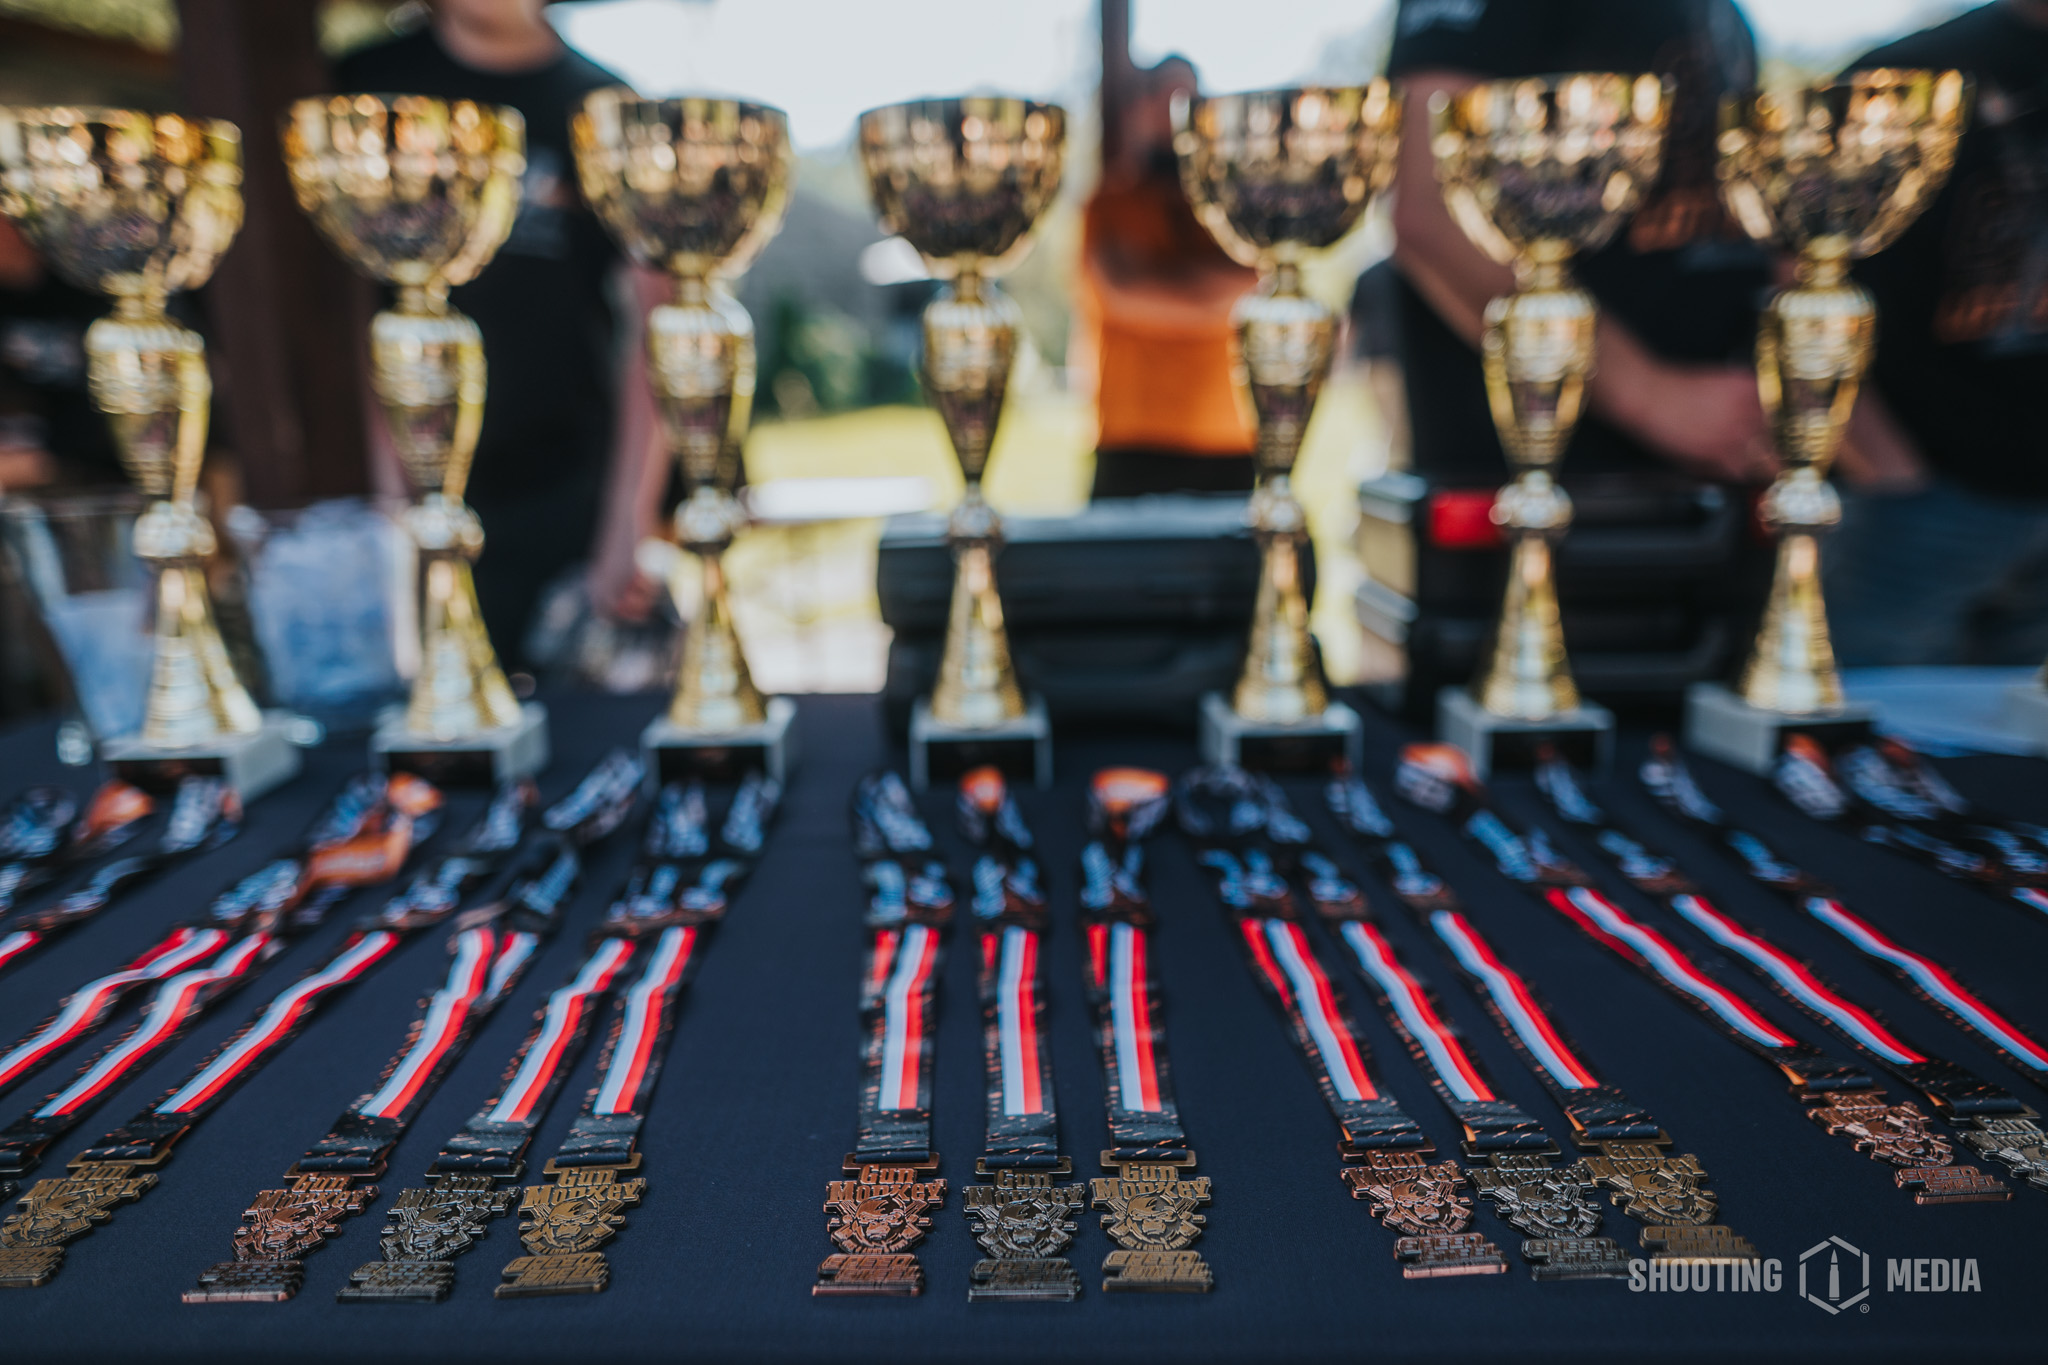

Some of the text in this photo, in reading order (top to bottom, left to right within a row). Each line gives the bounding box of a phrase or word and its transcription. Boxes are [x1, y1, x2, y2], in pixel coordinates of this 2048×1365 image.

[1366, 1150, 1427, 1169] Gun
[558, 1168, 614, 1187] Gun
[861, 1164, 914, 1184] Gun
[997, 1169, 1051, 1189] Gun
[1123, 1162, 1177, 1181] Gun
[292, 1173, 349, 1193] Gun
[828, 1180, 944, 1202] Monkey
[1093, 1178, 1209, 1200] Monkey
[522, 1183, 641, 1207] Monkey
[965, 1186, 1082, 1208] Monkey
